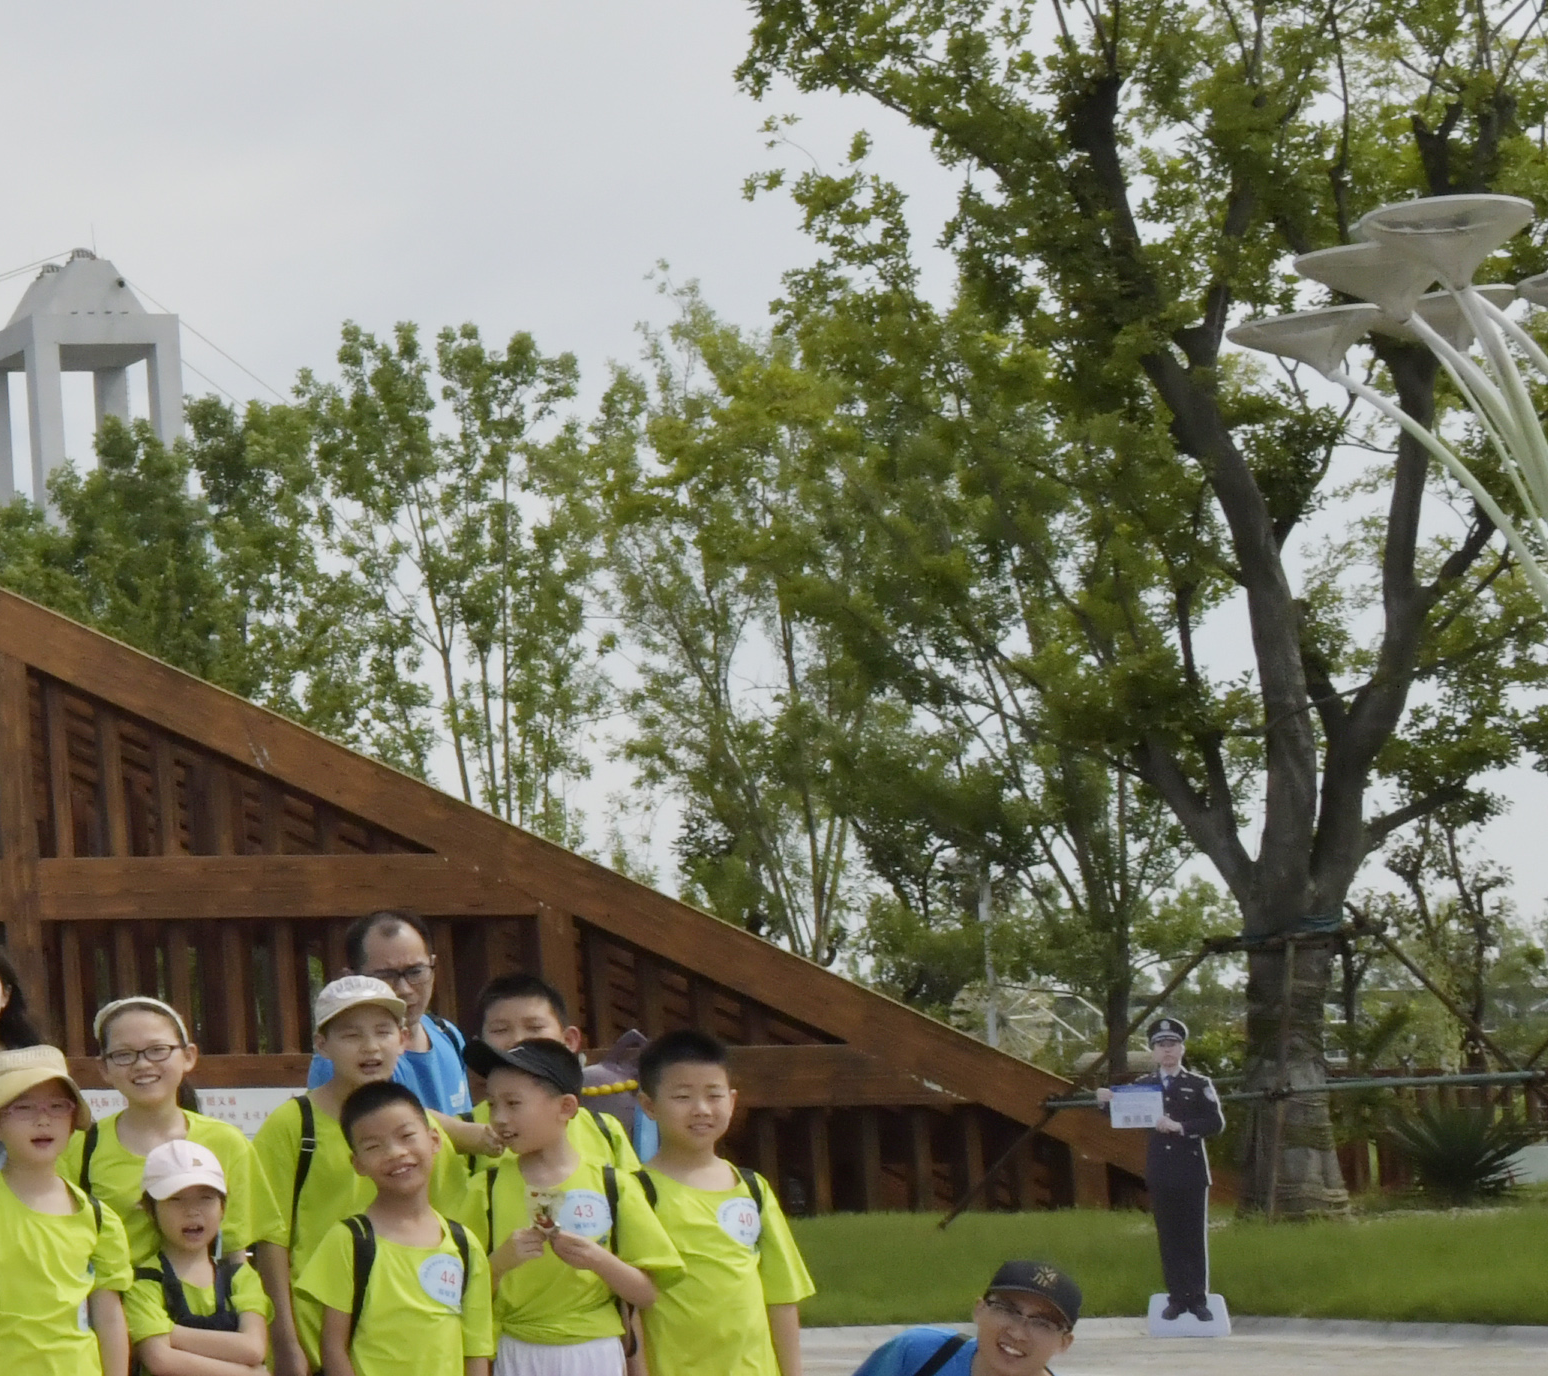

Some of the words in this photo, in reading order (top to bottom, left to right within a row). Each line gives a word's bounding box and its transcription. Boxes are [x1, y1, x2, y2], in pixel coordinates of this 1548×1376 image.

[573, 1204, 593, 1219] 43
[738, 1212, 753, 1227] 40
[440, 1271, 457, 1287] 44
